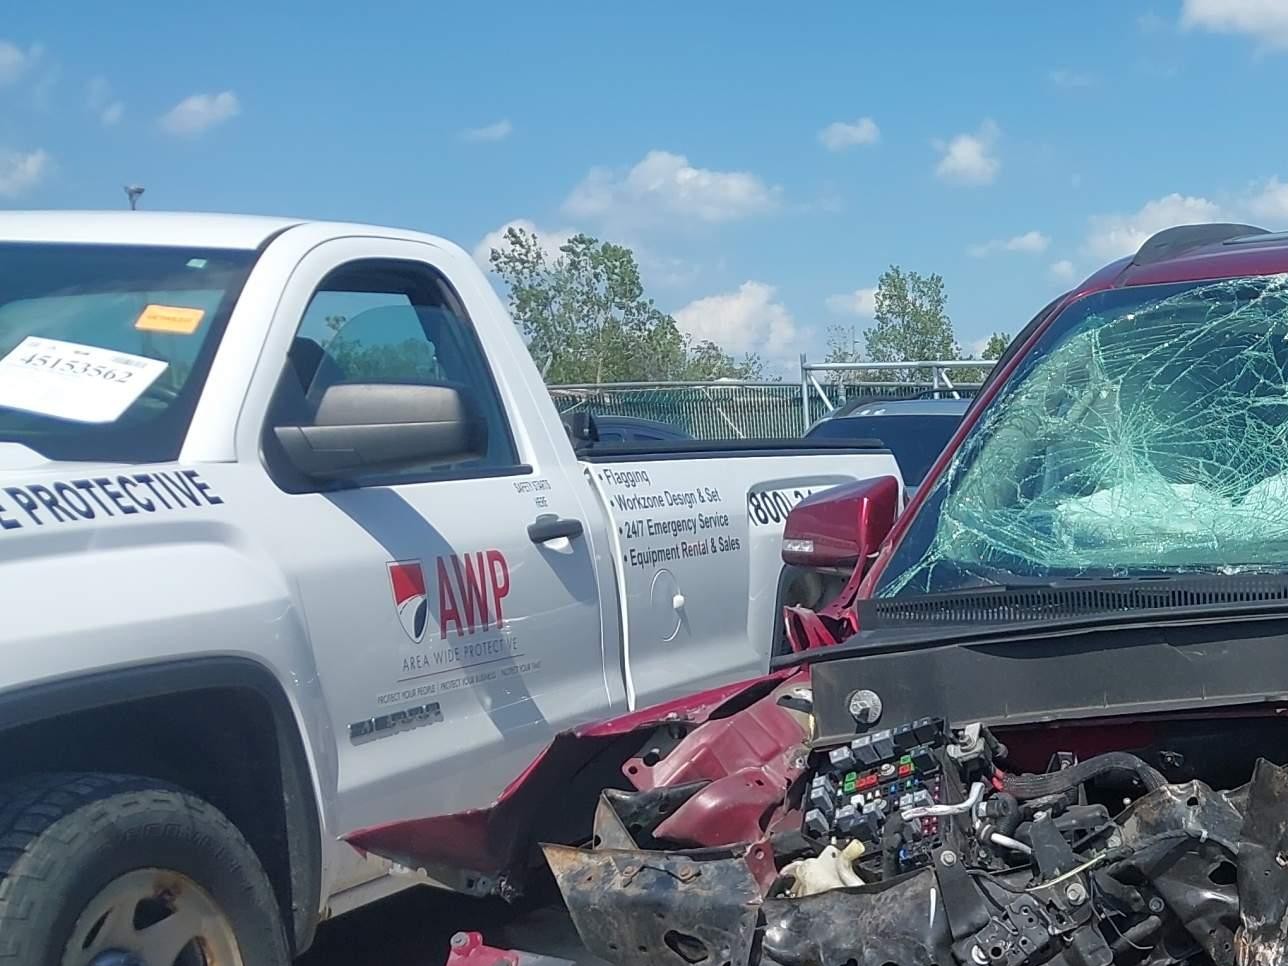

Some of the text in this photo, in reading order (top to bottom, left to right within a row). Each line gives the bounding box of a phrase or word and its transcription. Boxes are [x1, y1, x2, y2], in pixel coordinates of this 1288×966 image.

[20, 353, 134, 384] 45153562
[603, 469, 651, 487] Flagging
[2, 469, 225, 526] PROTECTIVE
[615, 489, 722, 512] Workzone Design & Set
[624, 513, 729, 539] 24/7 Emergency Service
[629, 536, 741, 568] Equipment Rental & Sales
[436, 548, 510, 640] AWP
[402, 636, 519, 673] AREA WIDE PROTECTVE
